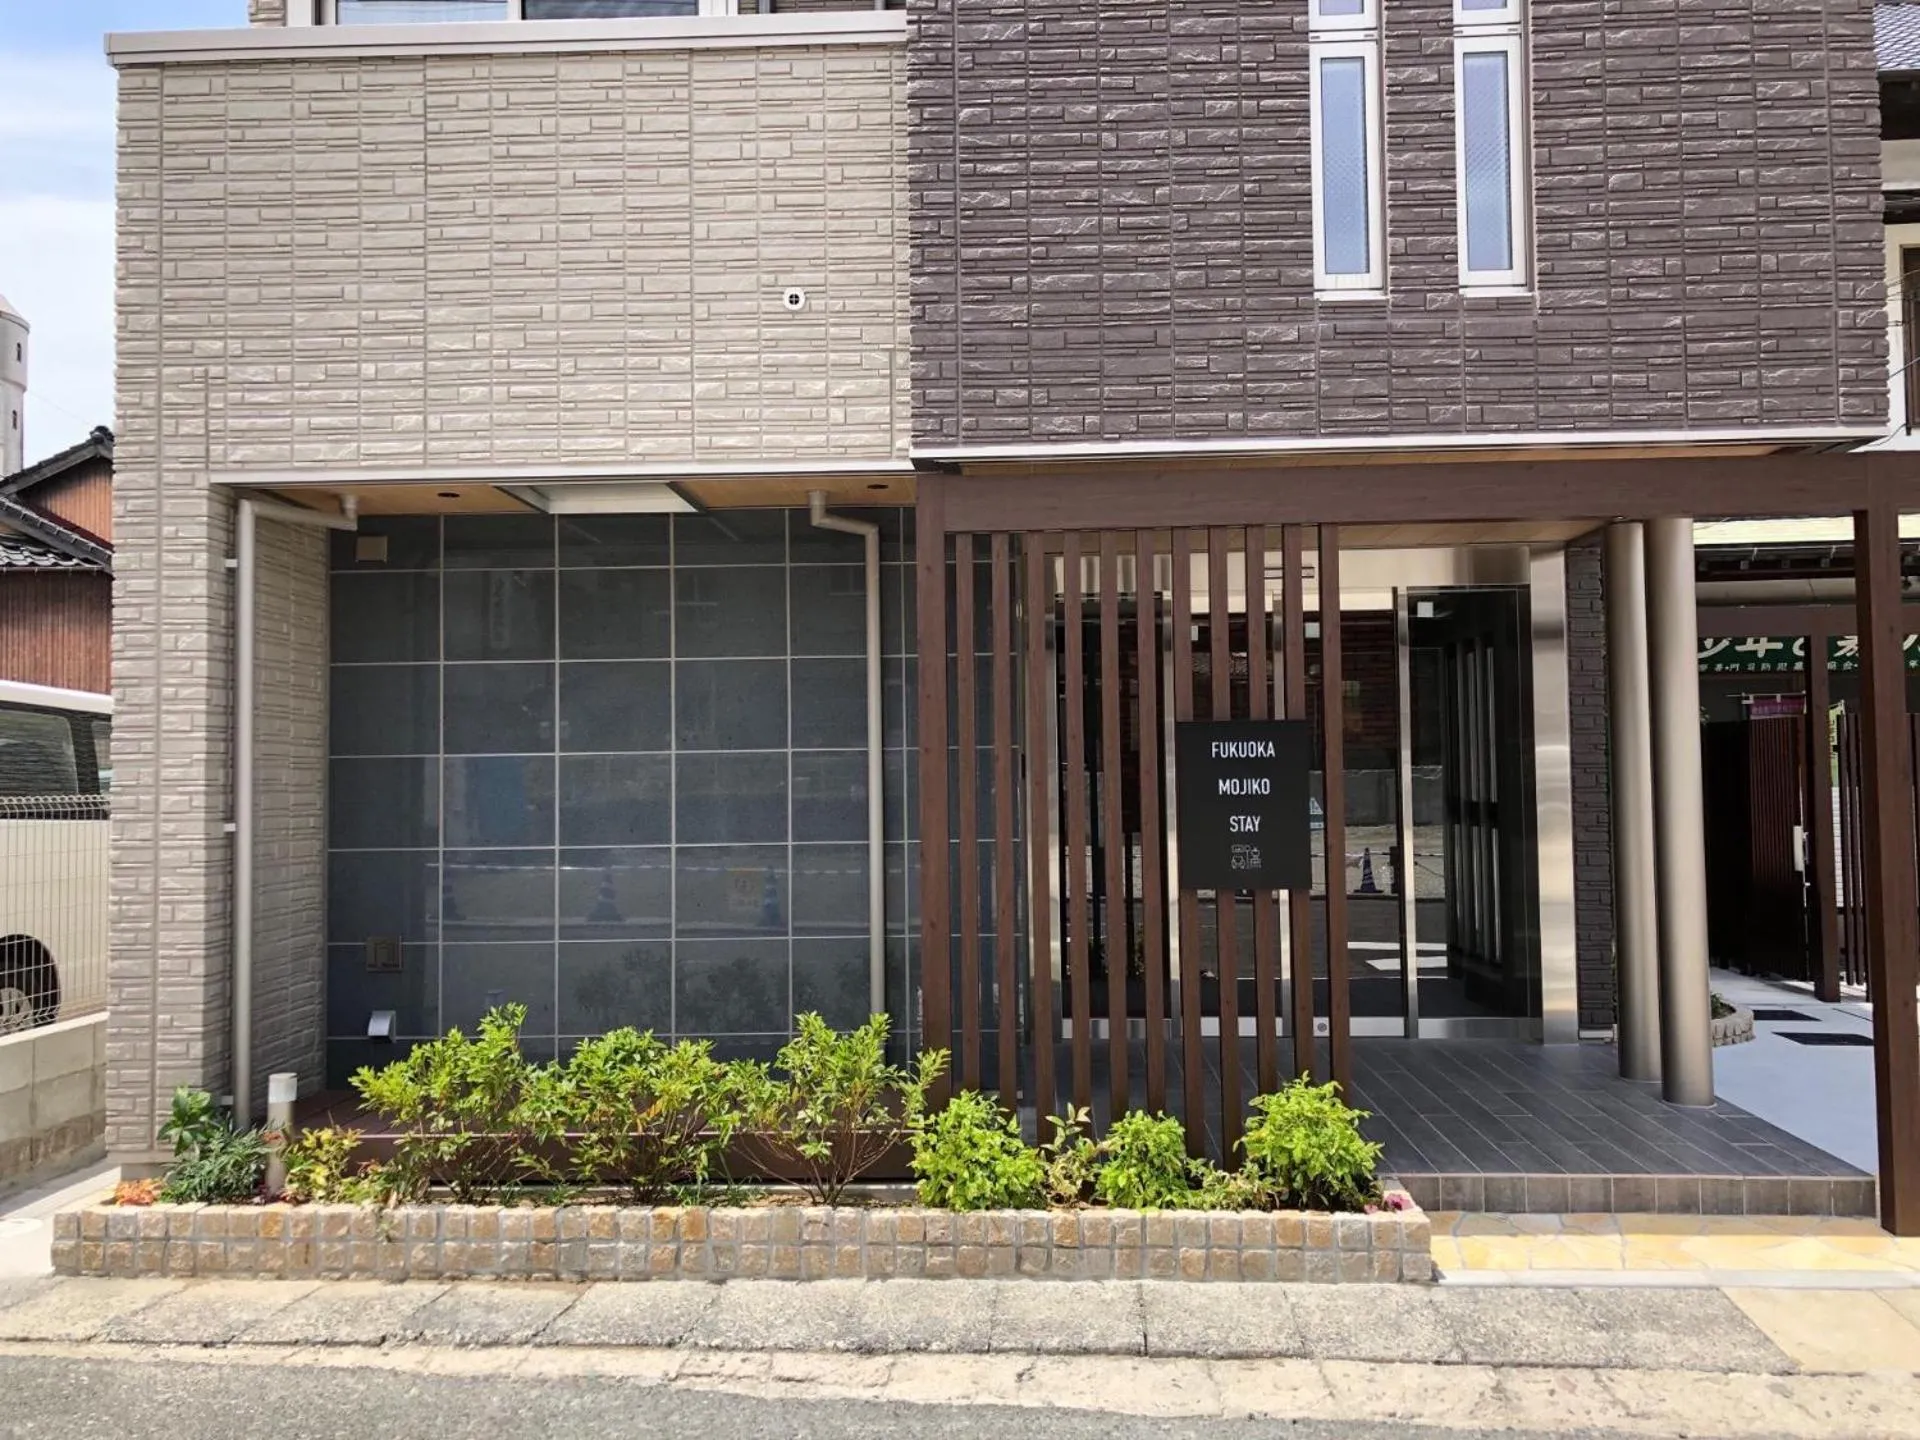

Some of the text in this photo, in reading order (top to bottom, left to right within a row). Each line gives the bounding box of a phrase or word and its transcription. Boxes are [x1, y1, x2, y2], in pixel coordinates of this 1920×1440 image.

[1211, 741, 1276, 758] FUKUOKA
[1218, 778, 1271, 795] MOJIKO
[1229, 815, 1261, 832] STAY
